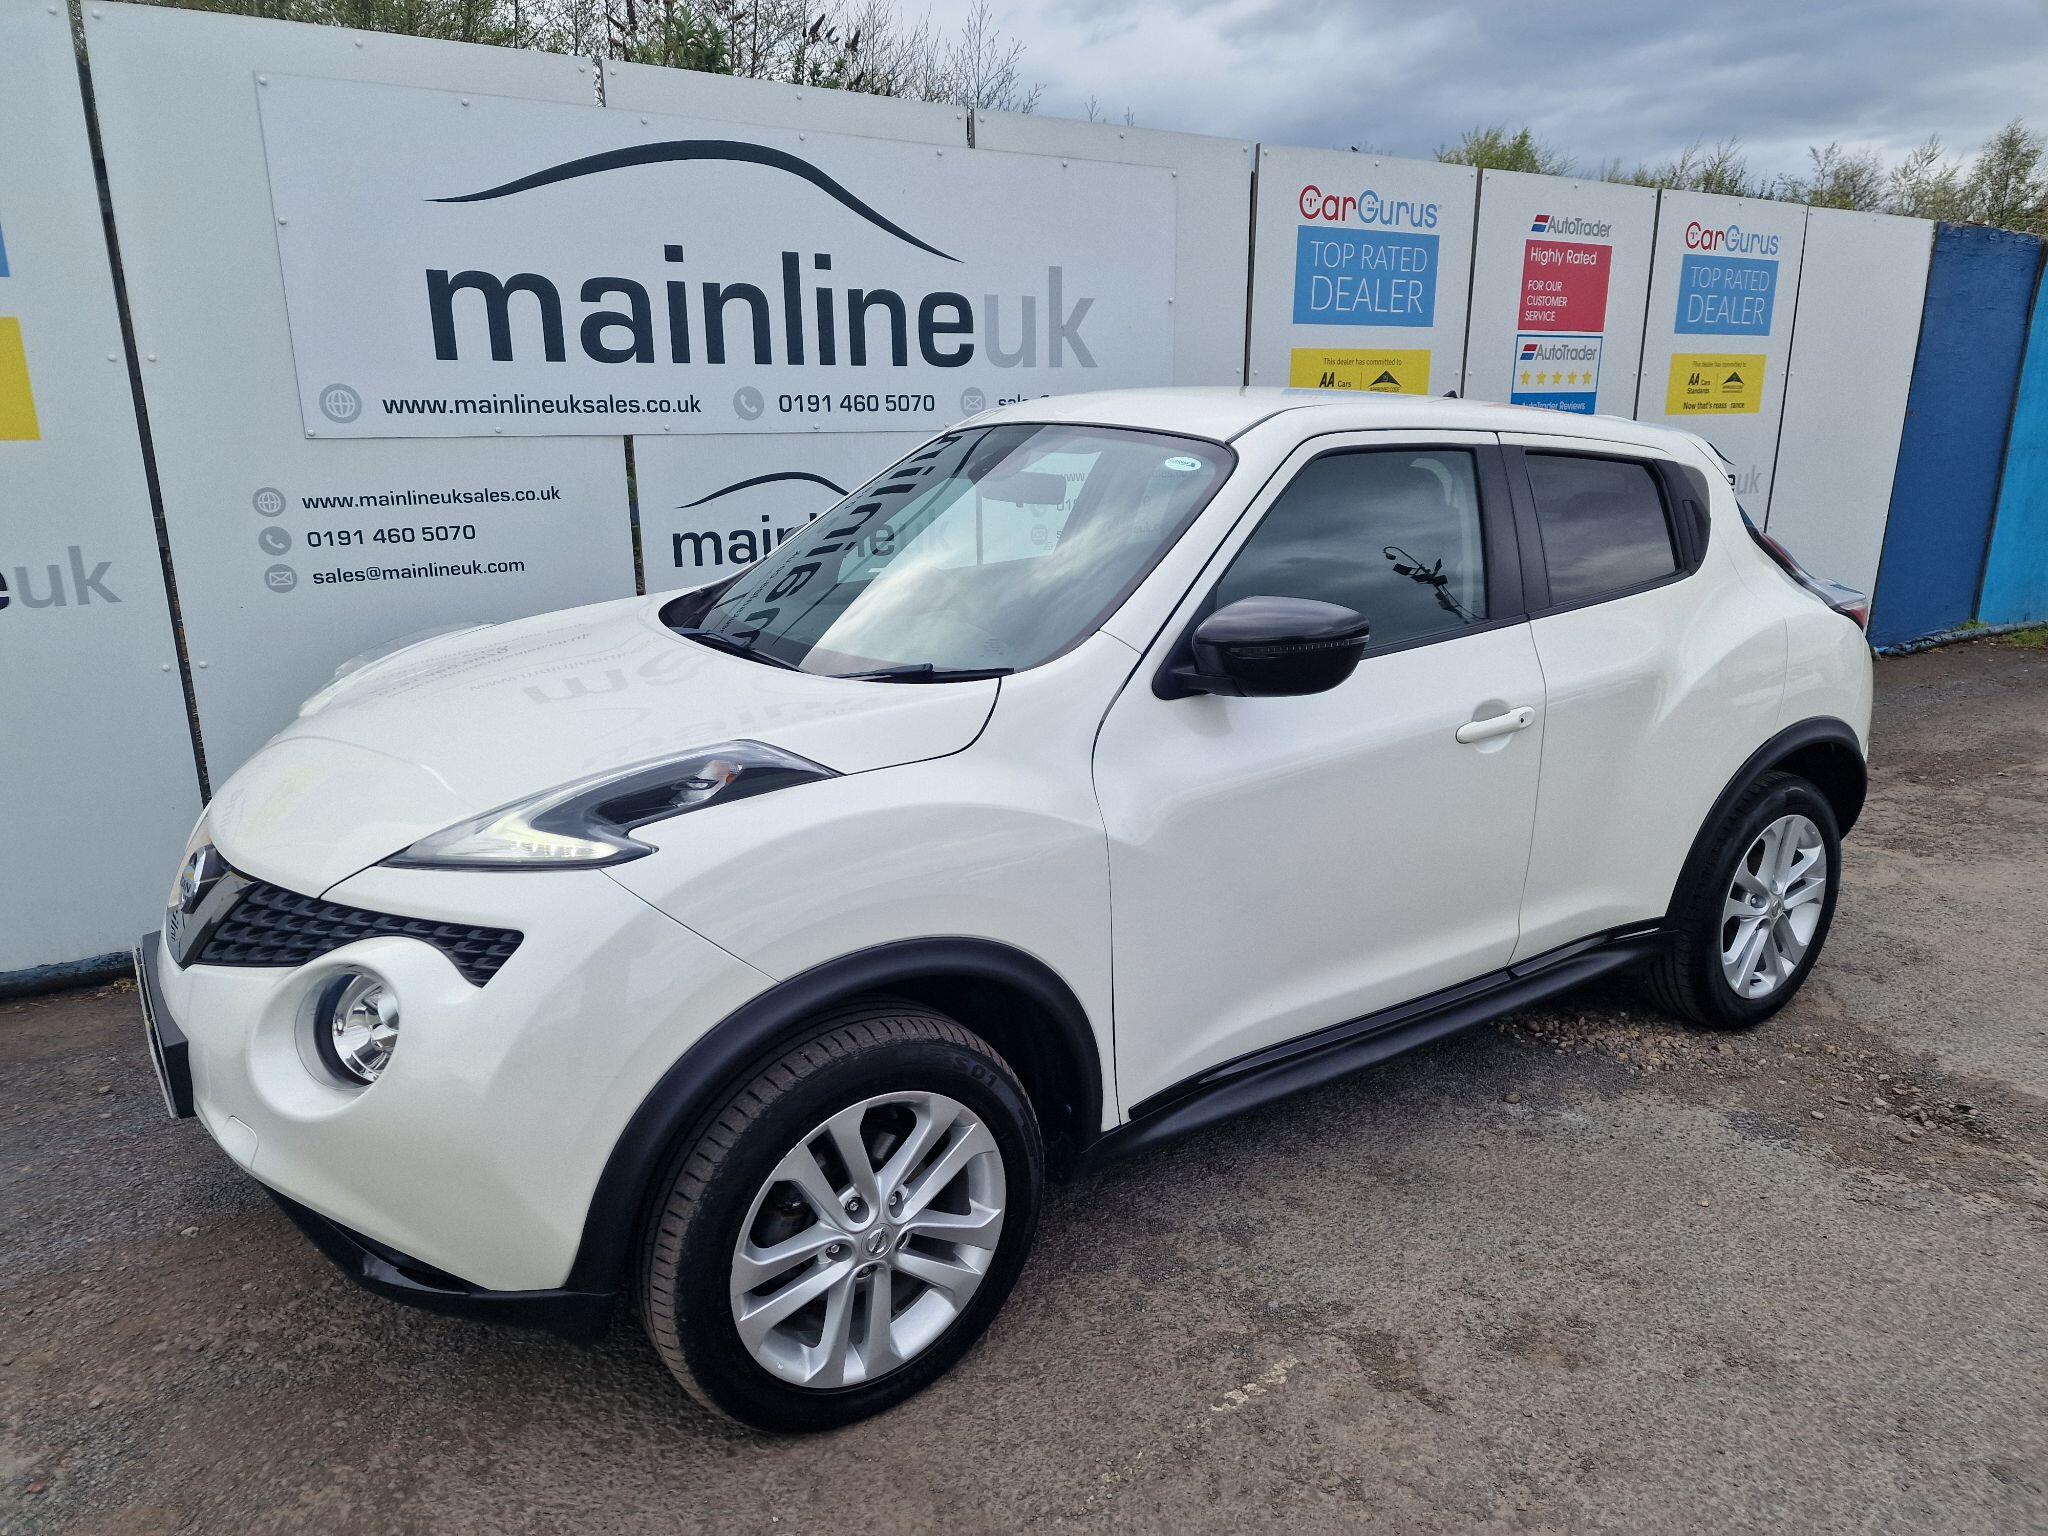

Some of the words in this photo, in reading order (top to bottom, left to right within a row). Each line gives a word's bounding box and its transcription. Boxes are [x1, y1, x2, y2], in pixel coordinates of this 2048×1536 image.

[1299, 184, 1438, 228] CarGurus
[1547, 215, 1612, 238] AutoTrader
[1685, 221, 1780, 255] CarGurus
[1310, 240, 1355, 268] TOP
[1361, 244, 1428, 273] RATED
[1530, 247, 1564, 266] Highly
[1566, 249, 1598, 265] Rated
[1527, 279, 1544, 291] FOR
[1545, 280, 1563, 292] OUR
[1690, 266, 1721, 289] TOP
[1724, 268, 1770, 292] RATED
[426, 244, 1099, 368] mainlineuk
[1310, 275, 1424, 314] DEALER
[1526, 295, 1568, 307] CUSTOMER
[1524, 310, 1556, 322] SERVICE
[1687, 294, 1766, 325] DEALER
[1336, 357, 1354, 366] dealer
[1355, 357, 1366, 366] has
[1535, 344, 1598, 361] AutoTrader
[1319, 371, 1335, 388] AA
[1337, 380, 1352, 388] Cars
[1688, 372, 1700, 386] AA
[382, 393, 702, 414] www.mainlineuksales.co.uk
[778, 394, 832, 413] 0191
[839, 394, 879, 412] 460
[885, 394, 935, 412] 5070
[1558, 400, 1586, 411] Reviews
[301, 485, 562, 509] www.mainlineuksales.co.uk
[307, 530, 365, 548] 0191
[372, 527, 416, 544] 460
[421, 524, 477, 542] 5070
[0, 545, 123, 611] uk
[312, 560, 526, 585] sales@mainlineuk.com
